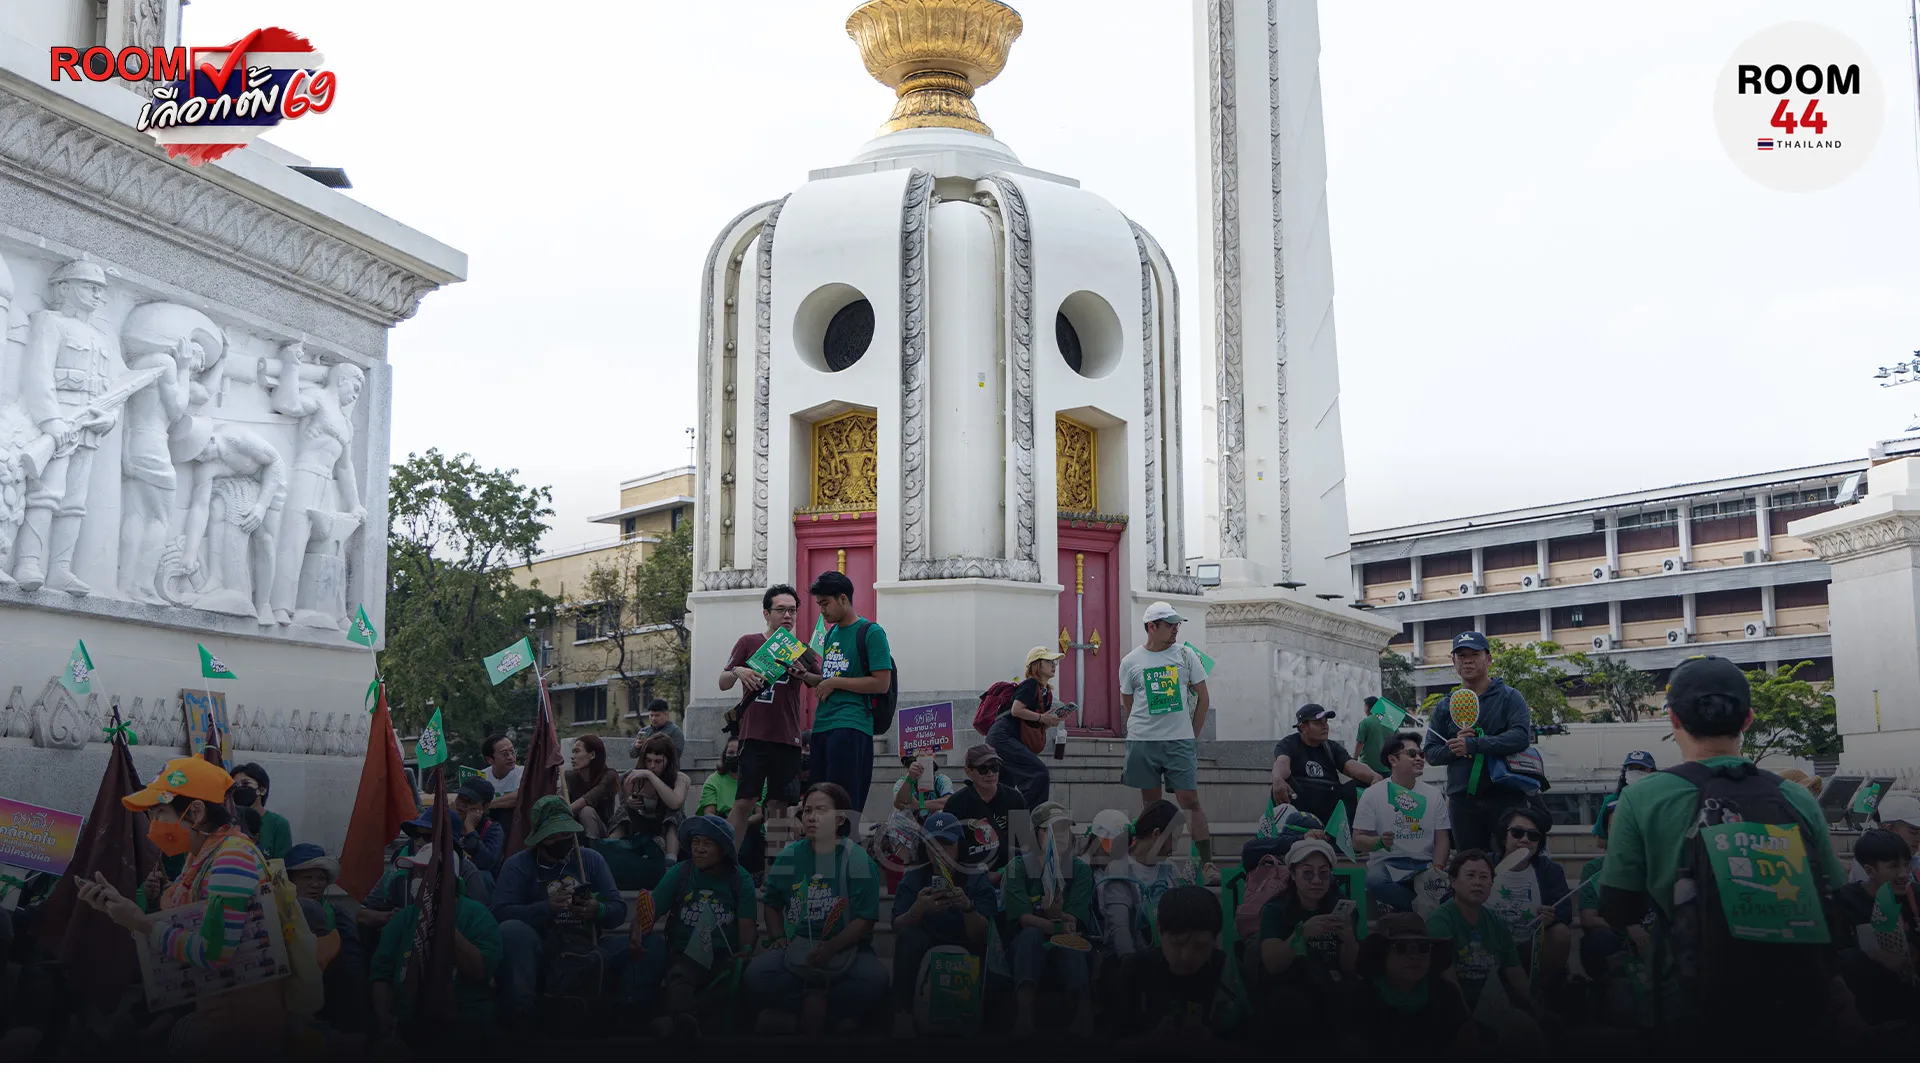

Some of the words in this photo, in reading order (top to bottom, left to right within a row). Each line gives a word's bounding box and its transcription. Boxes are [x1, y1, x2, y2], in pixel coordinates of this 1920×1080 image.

[1714, 833, 1729, 851] 8
[1734, 832, 1789, 856] กุมภา
[1756, 859, 1793, 878] กา
